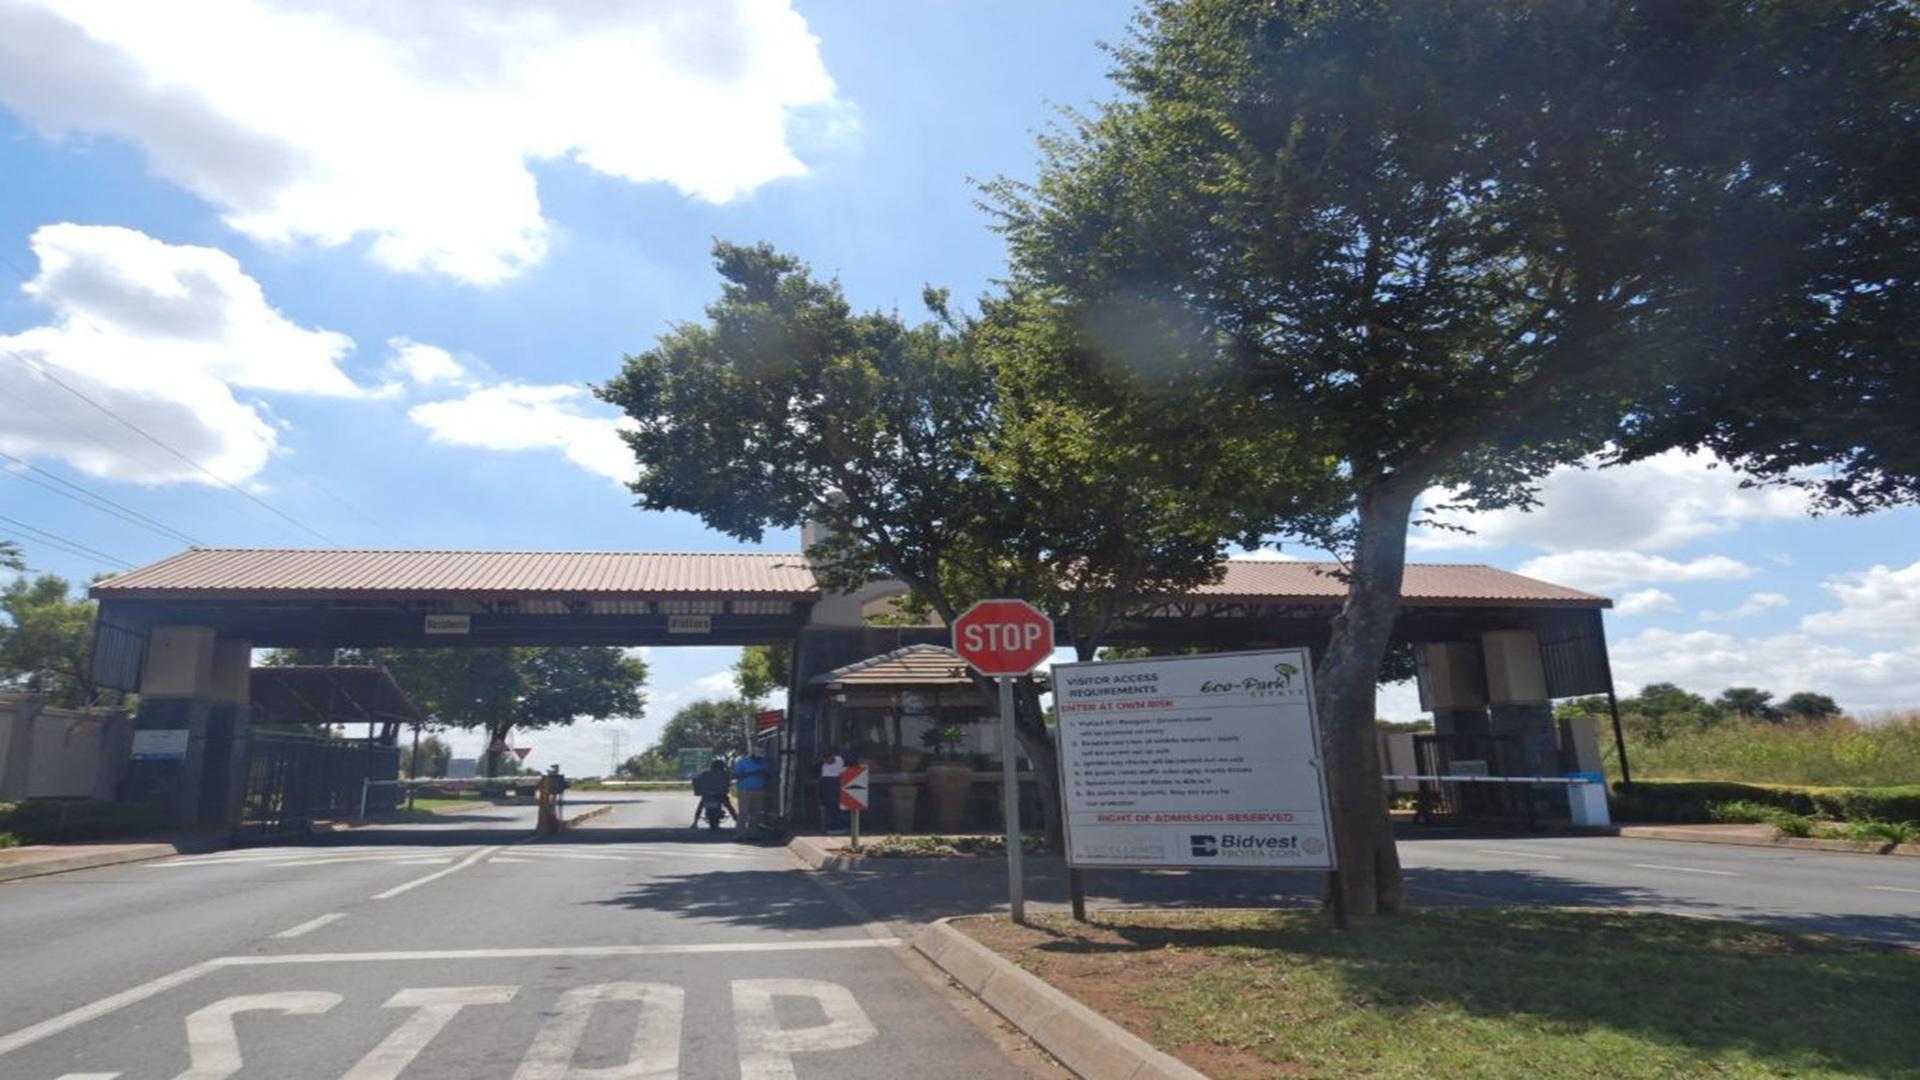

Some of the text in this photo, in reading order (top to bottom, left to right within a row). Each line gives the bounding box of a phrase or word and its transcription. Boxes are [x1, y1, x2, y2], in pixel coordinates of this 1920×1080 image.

[965, 623, 1042, 652] STOP
[1066, 672, 1159, 686] VISITOR ACCESS
[1069, 685, 1158, 697] REQUIREMENTS
[1061, 699, 1174, 713] ENTER AT OWN RISK
[1097, 813, 1294, 823] RIGHT OF ADMISSION RESERVED
[1221, 834, 1298, 849] Bidvest
[55, 978, 879, 1080] STOP
